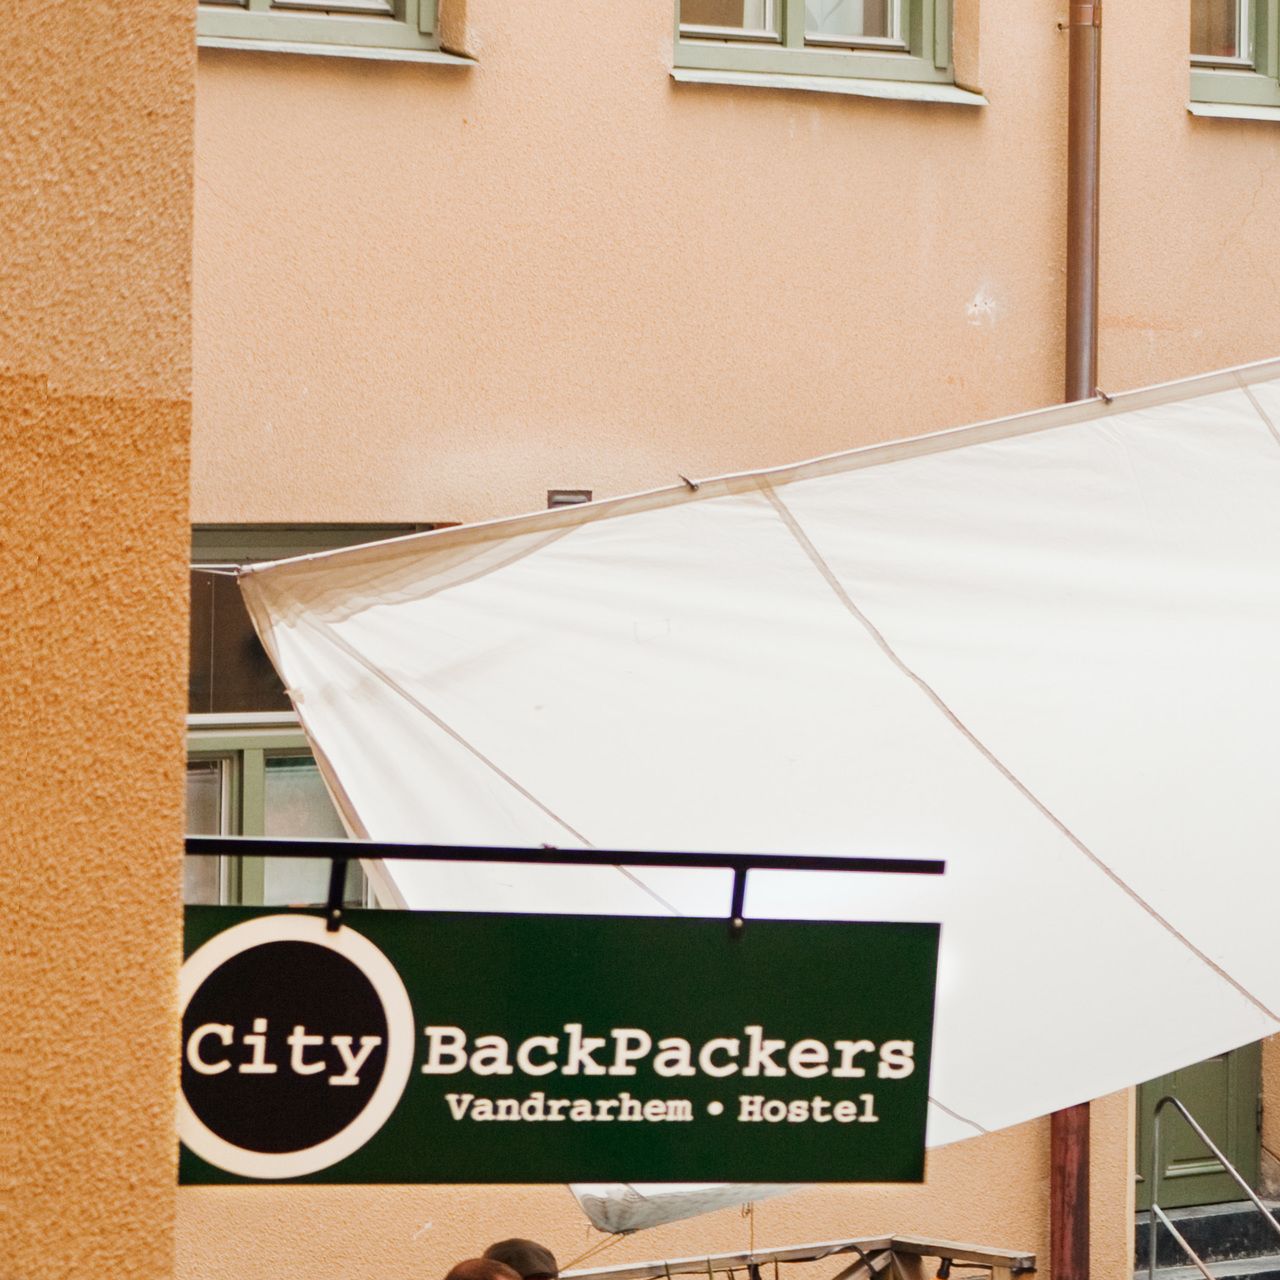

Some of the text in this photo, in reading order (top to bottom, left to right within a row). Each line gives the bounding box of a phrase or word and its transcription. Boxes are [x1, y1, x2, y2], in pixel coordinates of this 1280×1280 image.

[186, 1018, 382, 1087] City
[421, 1023, 916, 1080] BackPackers
[445, 1092, 879, 1123] Vandrarhem Hostel
